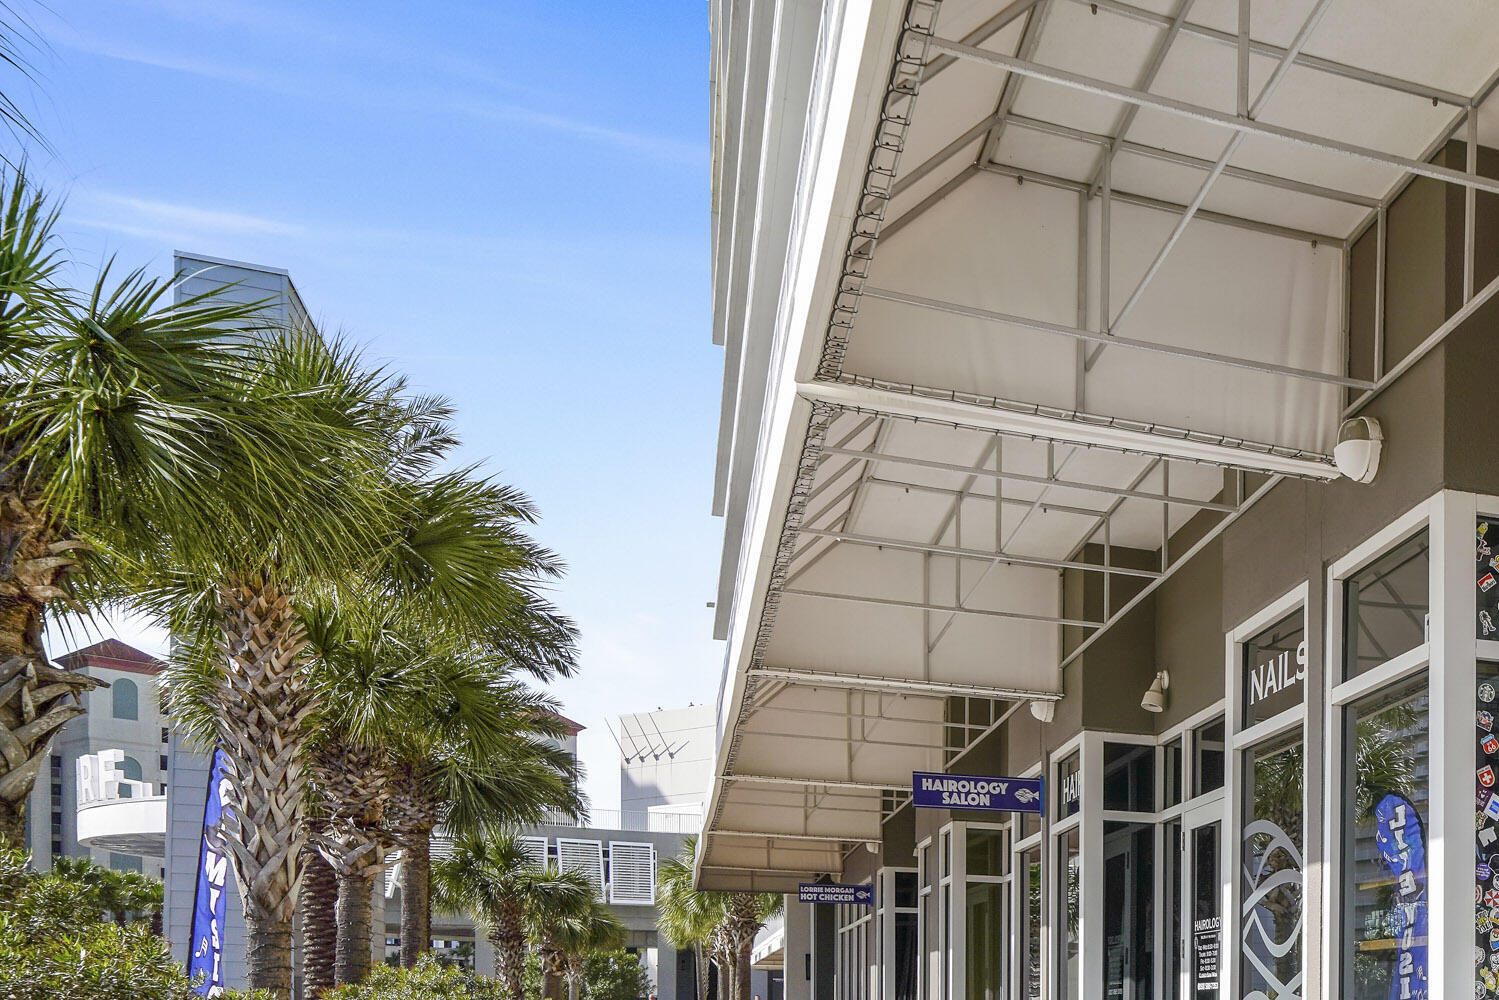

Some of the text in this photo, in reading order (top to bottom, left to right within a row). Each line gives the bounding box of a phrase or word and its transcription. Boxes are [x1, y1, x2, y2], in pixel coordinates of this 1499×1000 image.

[1250, 641, 1305, 705] NAILS
[922, 778, 1009, 795] HAIROLOGY
[942, 791, 991, 807] SALON
[800, 893, 855, 902] HOT CHICKEN
[1194, 917, 1221, 932] HAIROLOG
